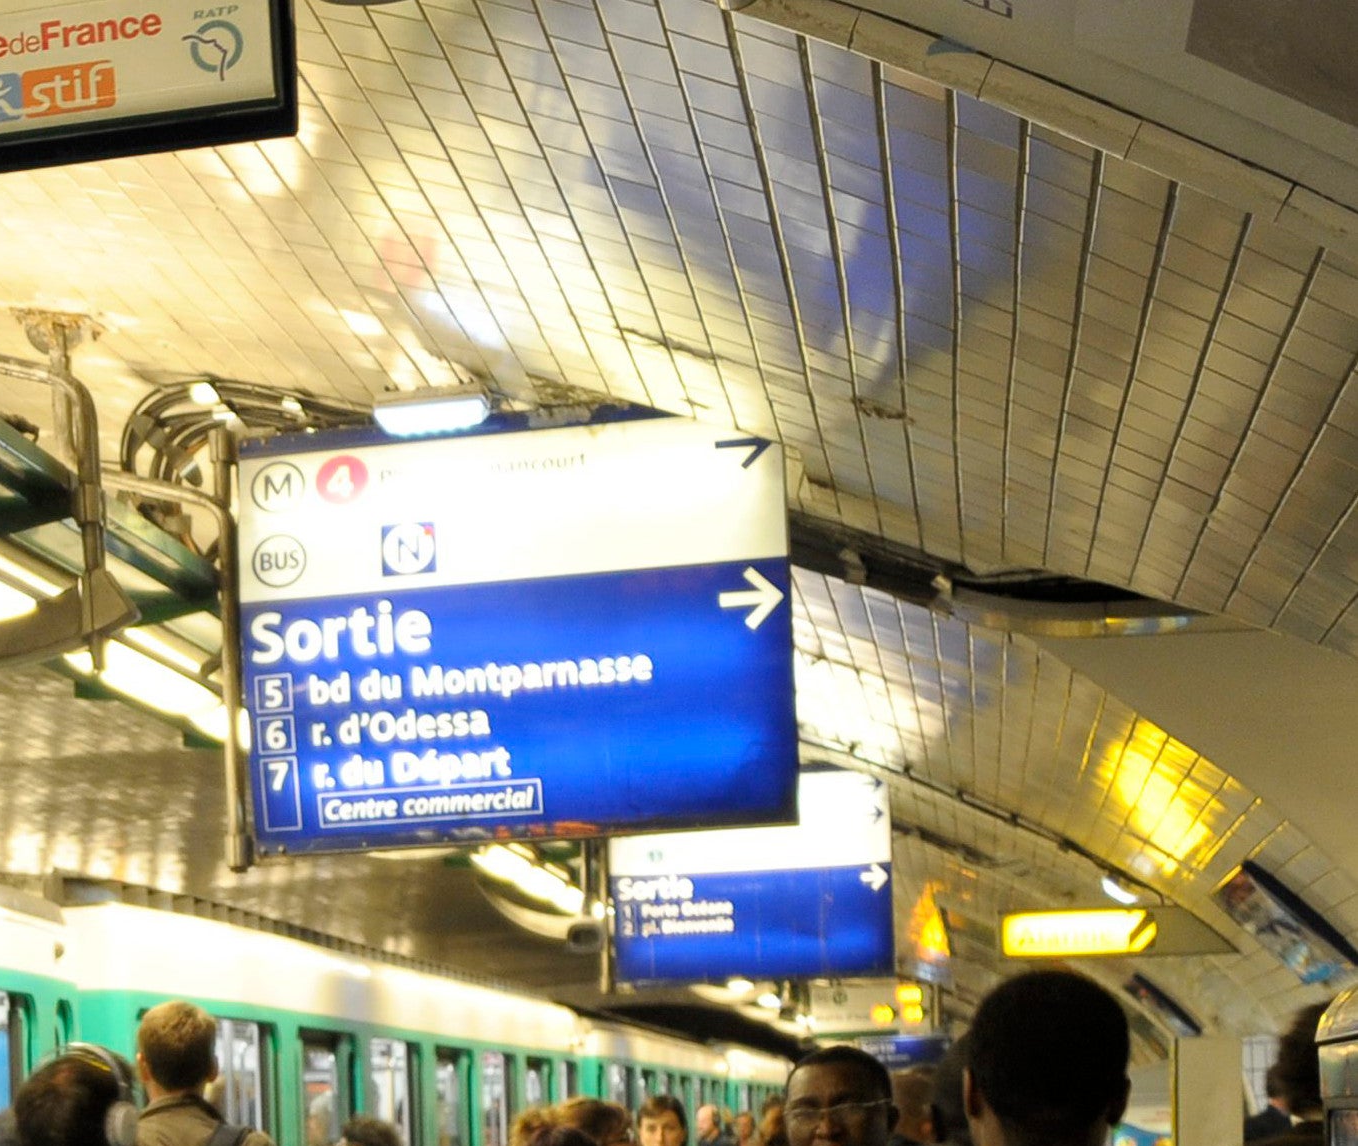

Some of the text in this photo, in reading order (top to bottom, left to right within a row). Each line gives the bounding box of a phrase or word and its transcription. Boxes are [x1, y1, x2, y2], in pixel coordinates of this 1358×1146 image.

[193, 5, 239, 20] RATP
[32, 60, 115, 115] stif
[264, 473, 292, 502] M
[326, 464, 355, 497] 4
[260, 550, 300, 572] BUS
[397, 535, 420, 563] N
[251, 600, 433, 664] Sortie
[265, 653, 654, 708] 5 bd du Montparnasse
[265, 708, 491, 750] 6 r. d'Odessa
[270, 746, 512, 791] 7 r. du Départ
[324, 786, 535, 821] Centre commercial
